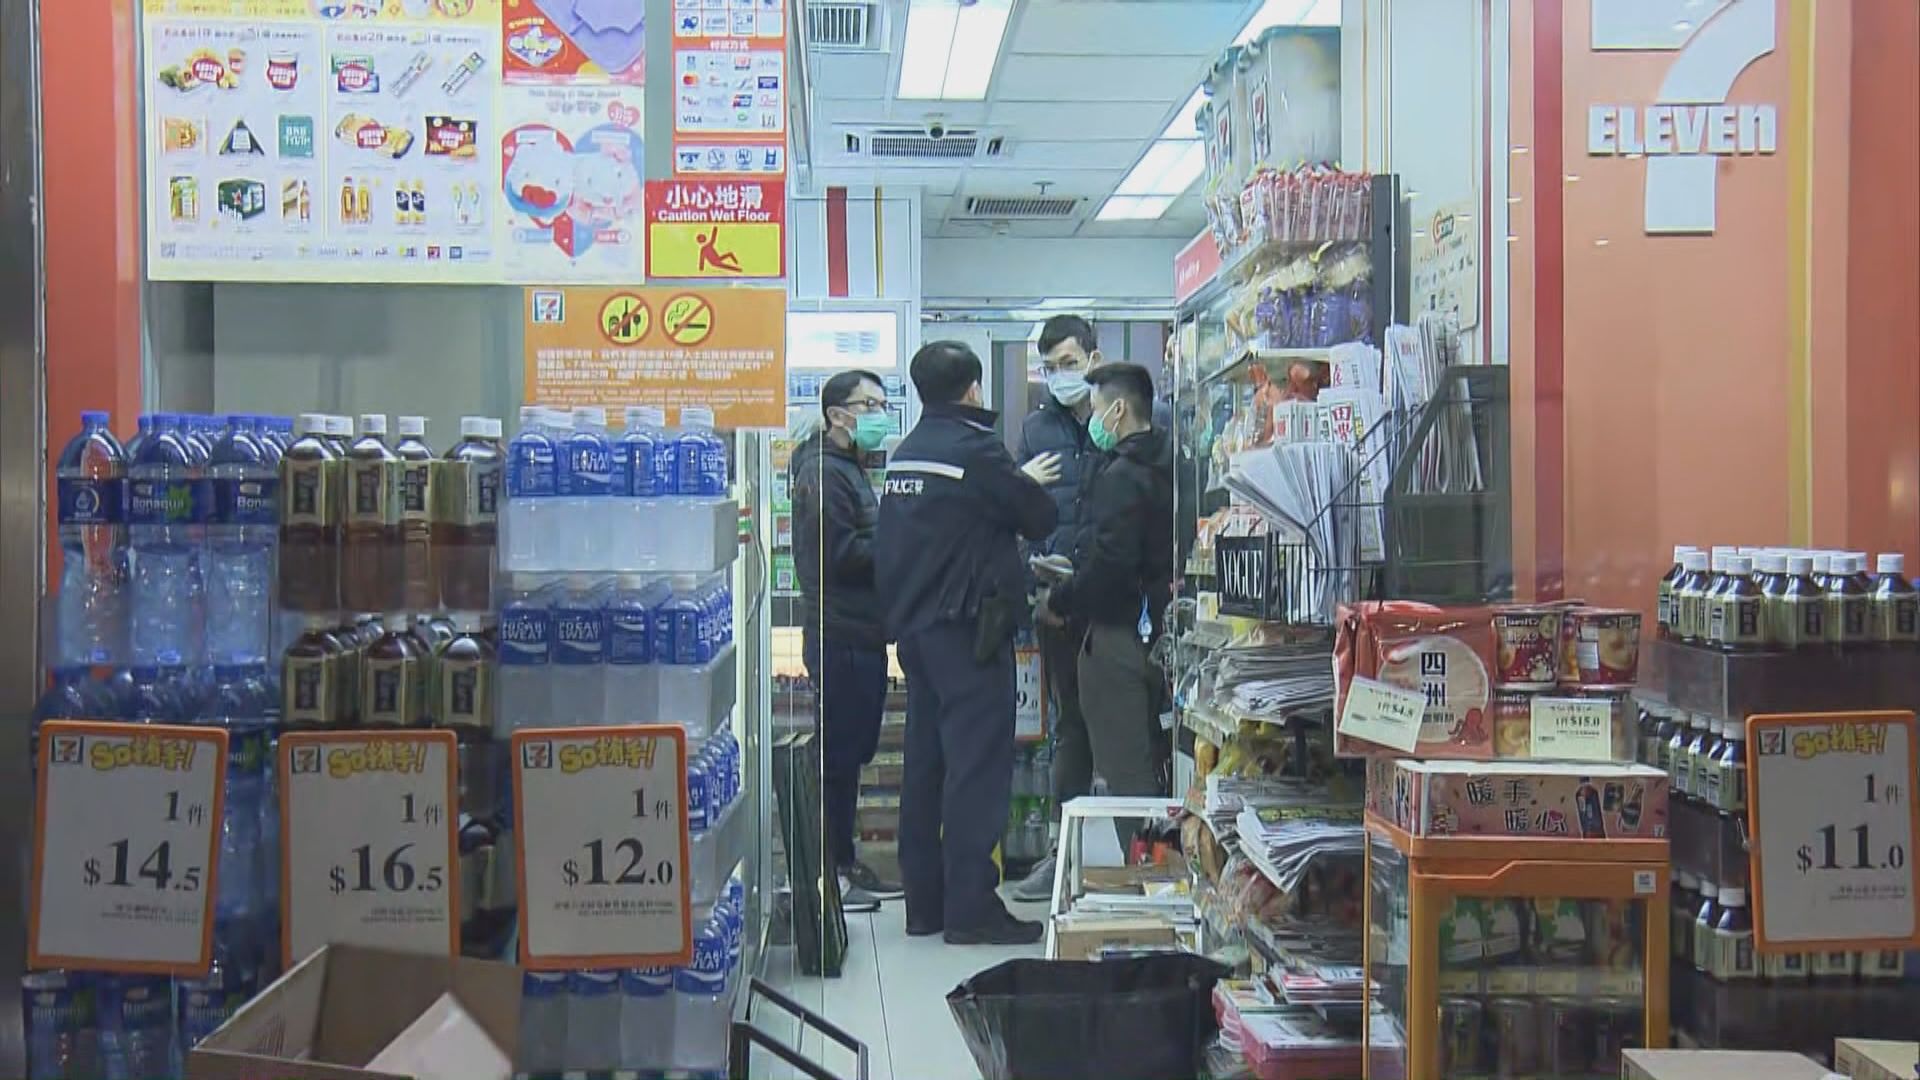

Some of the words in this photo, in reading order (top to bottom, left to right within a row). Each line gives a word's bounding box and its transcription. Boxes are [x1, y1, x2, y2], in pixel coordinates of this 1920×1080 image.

[658, 209, 707, 222] Caution
[710, 209, 735, 221] Wet
[738, 209, 770, 221] Floor
[1221, 550, 1264, 599] VOGUE
[83, 837, 201, 892] $14.5
[329, 842, 443, 895] $16.5
[563, 837, 674, 889] $12.0
[1796, 823, 1905, 875] $11.0
